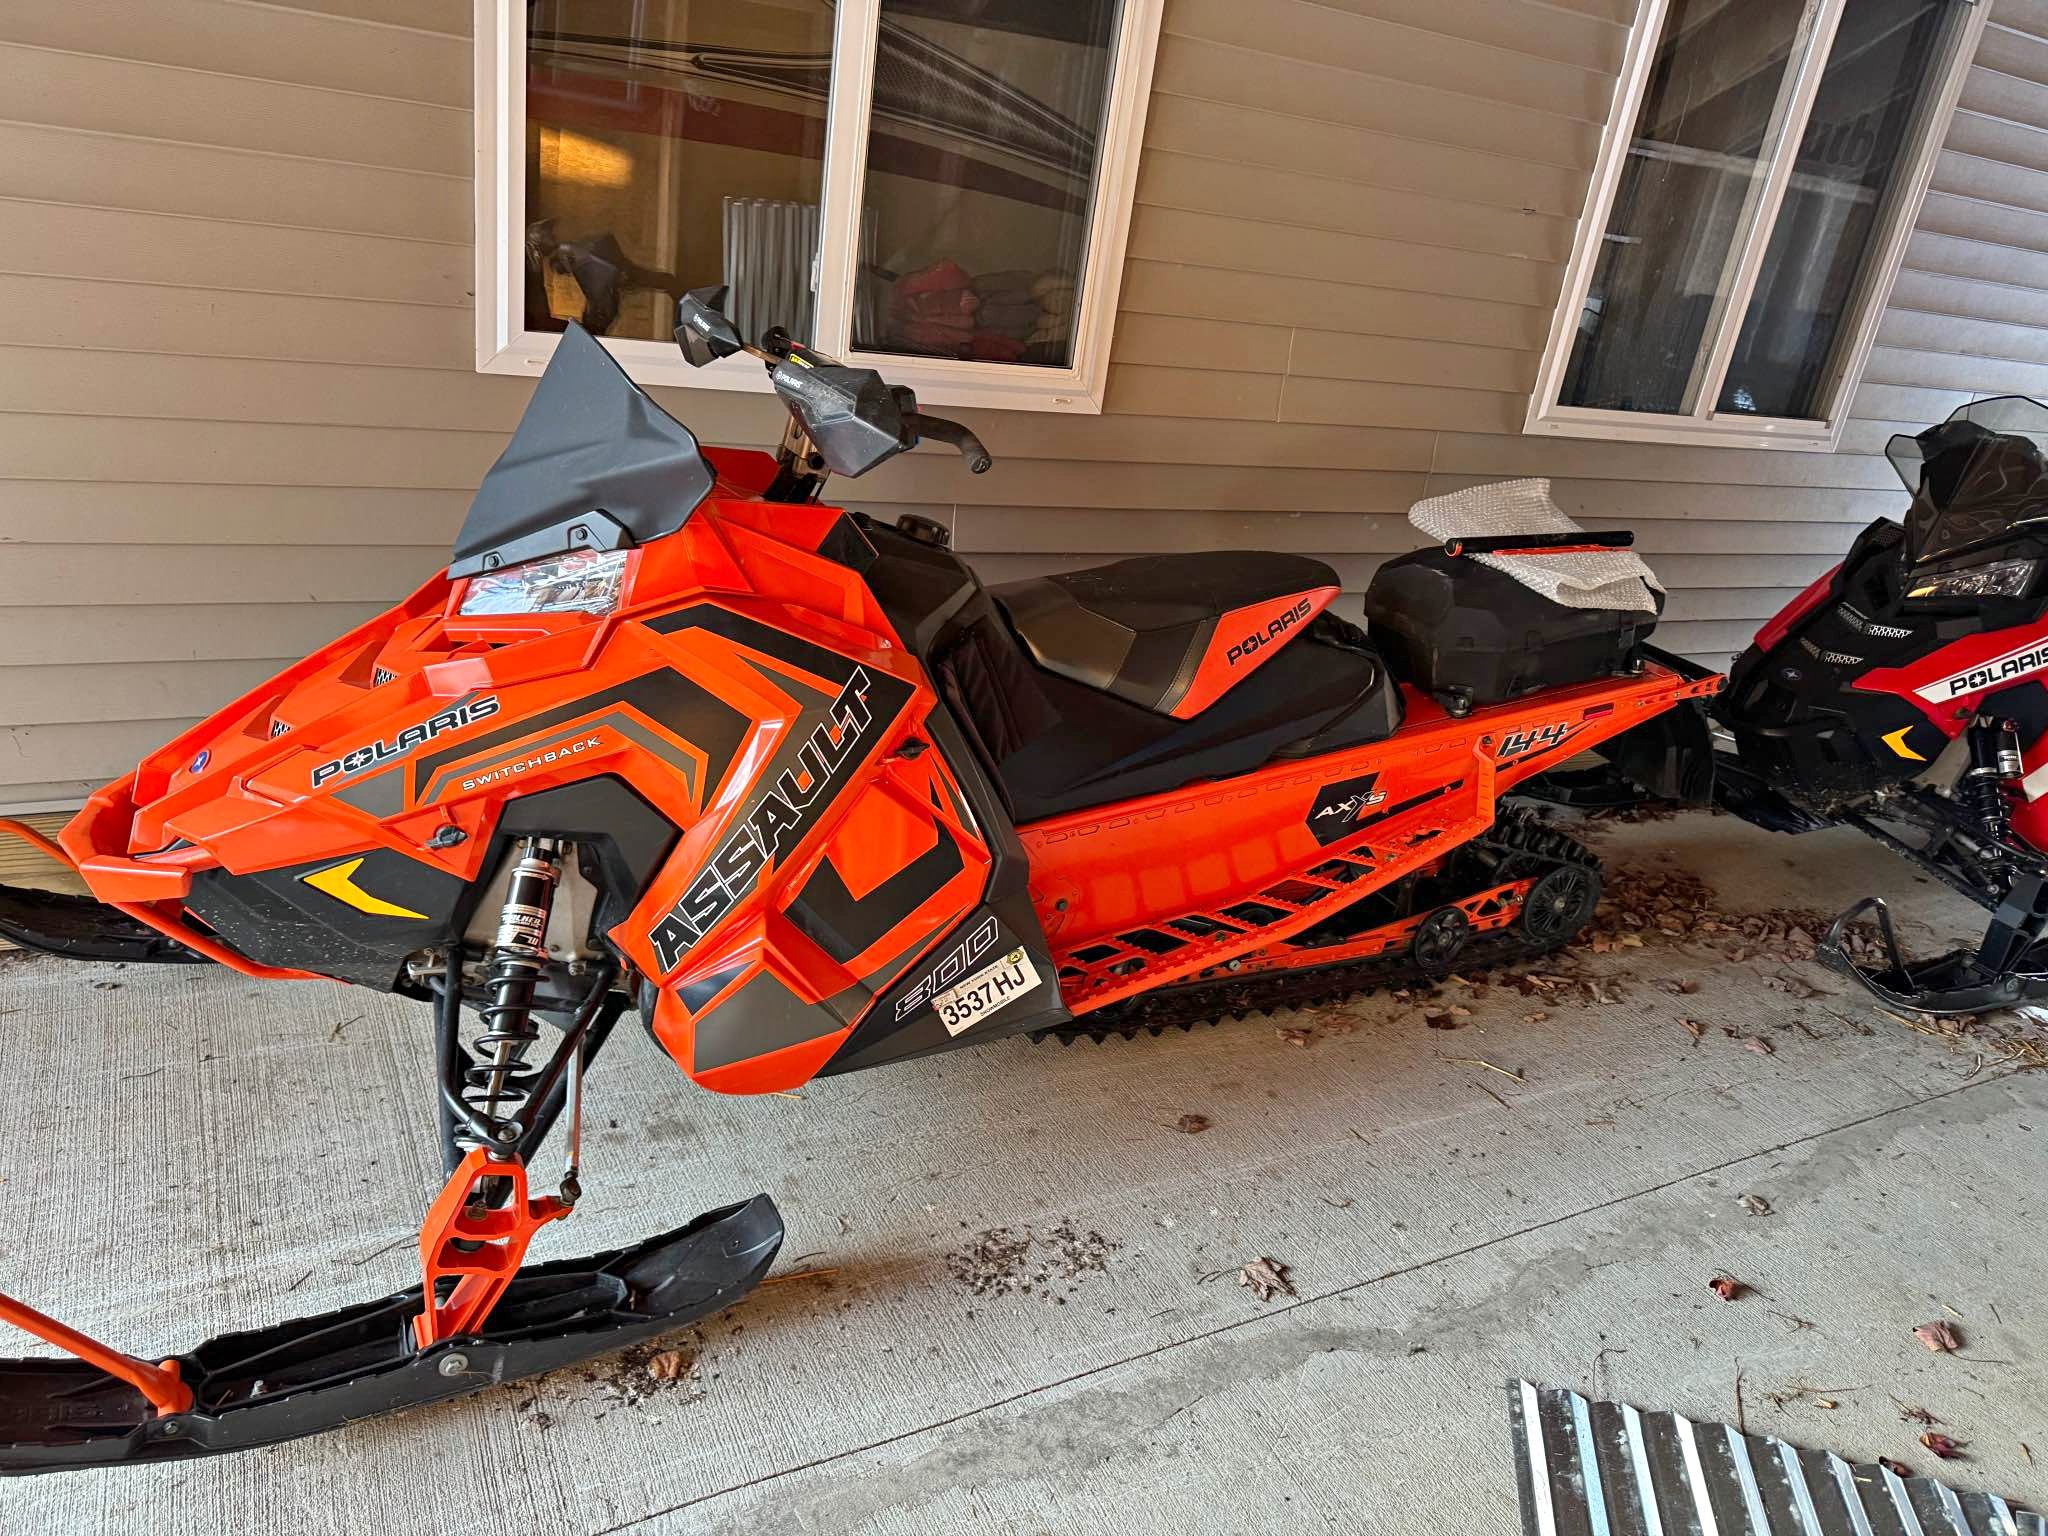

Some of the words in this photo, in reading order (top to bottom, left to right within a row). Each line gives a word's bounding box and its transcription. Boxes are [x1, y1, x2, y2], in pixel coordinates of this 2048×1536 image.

[1226, 597, 1312, 666] POLARIS
[312, 695, 500, 789] POLARIS
[462, 735, 601, 791] SWITCHBACK
[1496, 721, 1568, 757] 144
[647, 665, 872, 974] ASSAULT
[895, 916, 999, 1021] 800
[943, 964, 1026, 1026] 3537HJ
[980, 995, 1010, 1017] SNOWMOBILE
